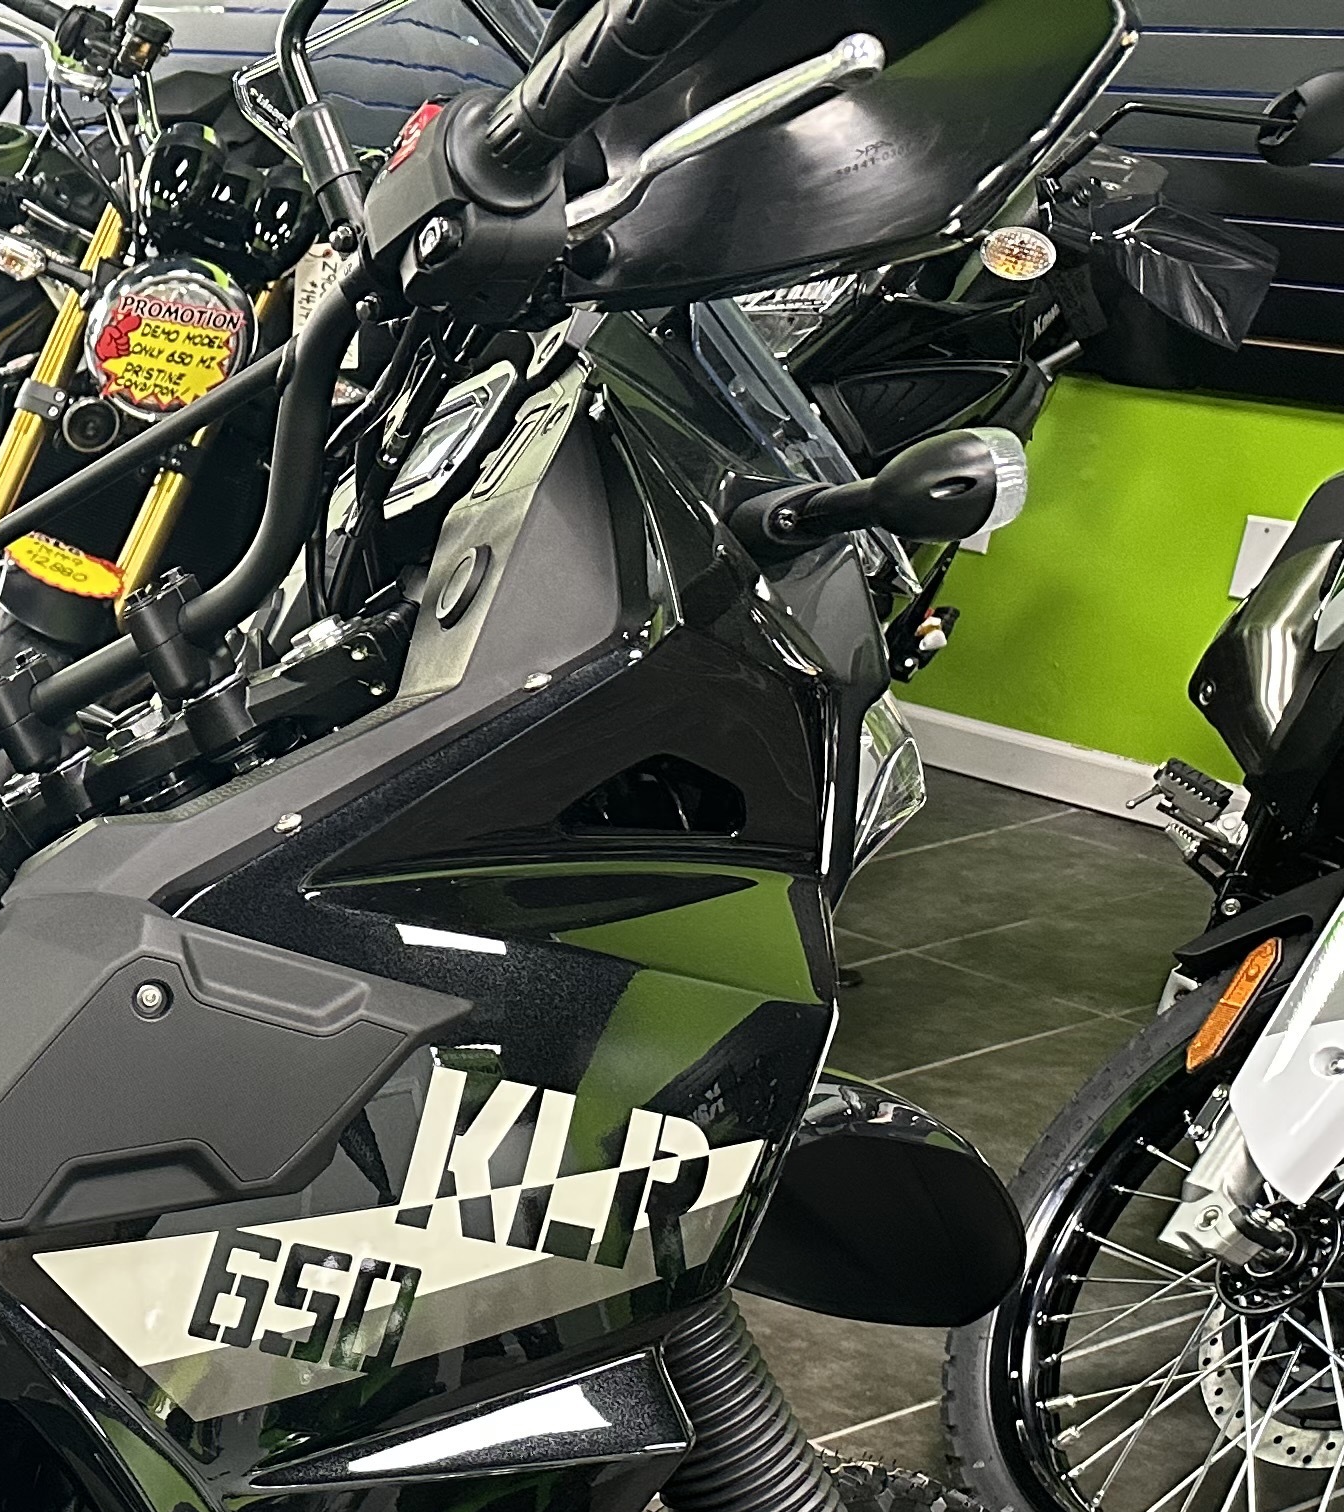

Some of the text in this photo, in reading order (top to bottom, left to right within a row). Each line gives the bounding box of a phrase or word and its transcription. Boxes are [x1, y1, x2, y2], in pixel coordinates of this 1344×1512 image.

[121, 296, 241, 330] PROMOTION
[140, 322, 225, 350] DEMO MODEL
[129, 342, 165, 360] ONLY
[166, 351, 194, 367] 650
[122, 362, 187, 386] PRISTINE
[392, 1065, 712, 1286] KLR
[187, 1225, 424, 1374] 650
